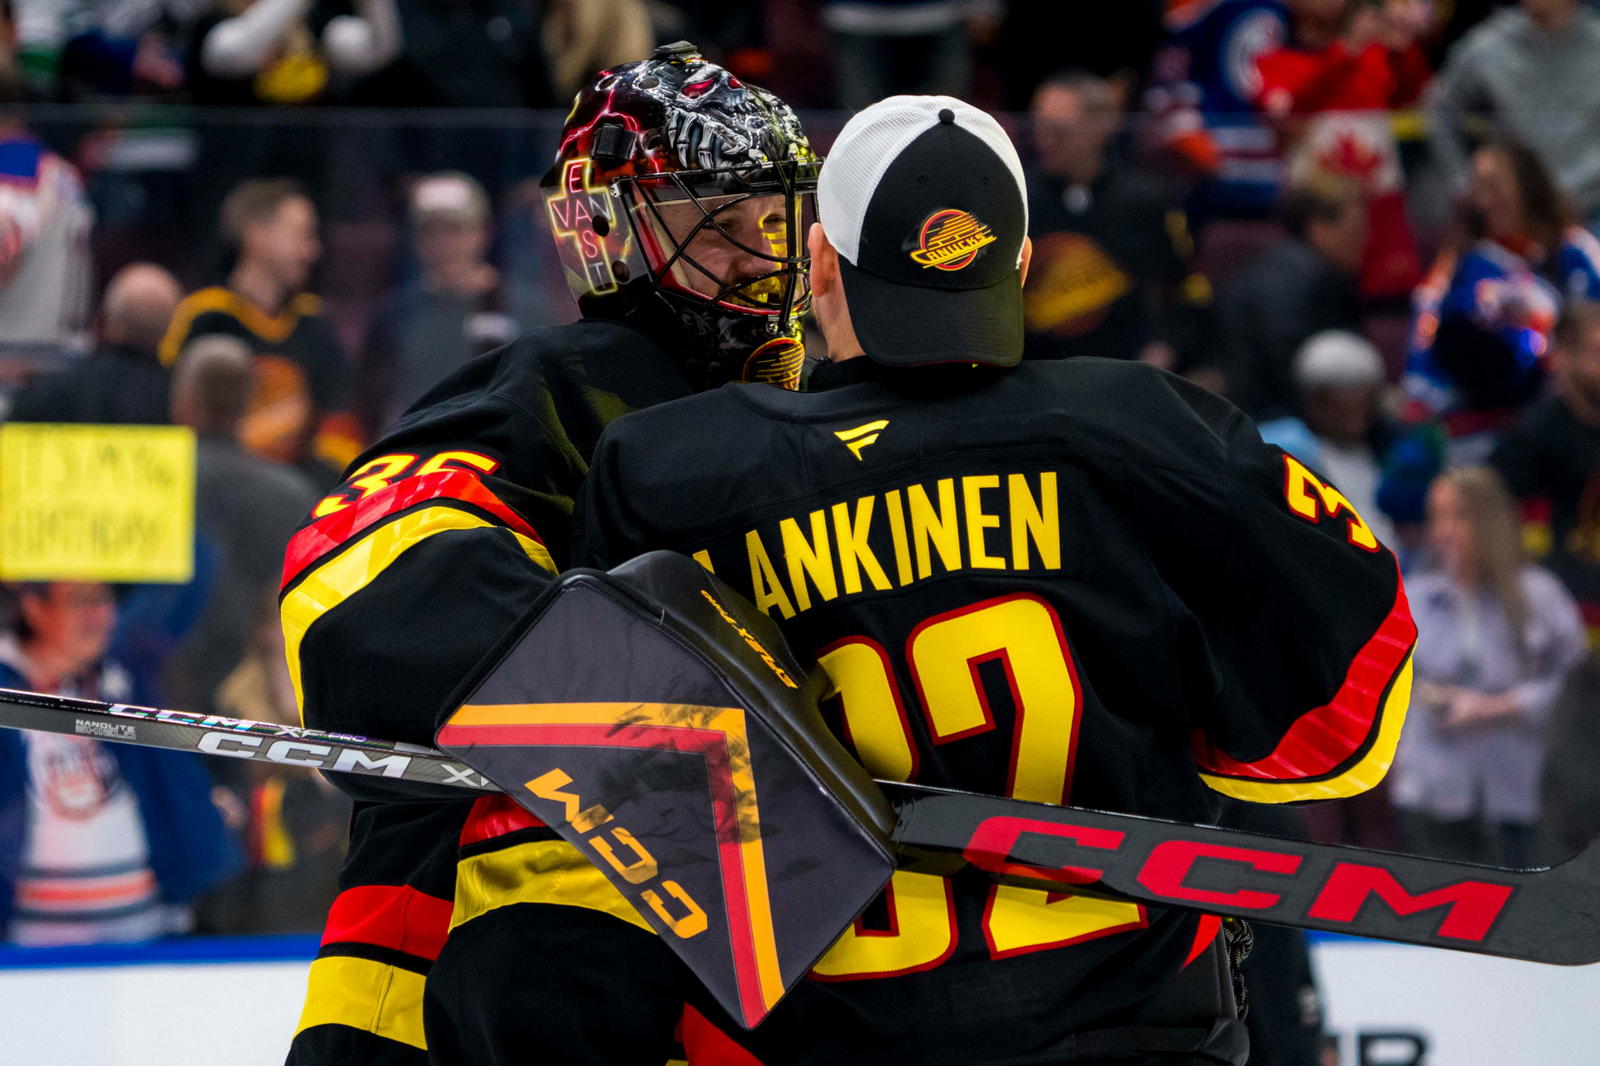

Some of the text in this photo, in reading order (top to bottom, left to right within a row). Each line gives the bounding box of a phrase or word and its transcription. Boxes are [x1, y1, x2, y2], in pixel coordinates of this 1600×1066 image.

[910, 230, 997, 266] CANUCKS
[692, 471, 1062, 620] ANKINEN
[75, 719, 136, 733] NANOLITE
[108, 703, 257, 731] CCM
[197, 731, 490, 787] CCM X
[524, 768, 709, 939] CCM
[963, 815, 1514, 942] CCM
